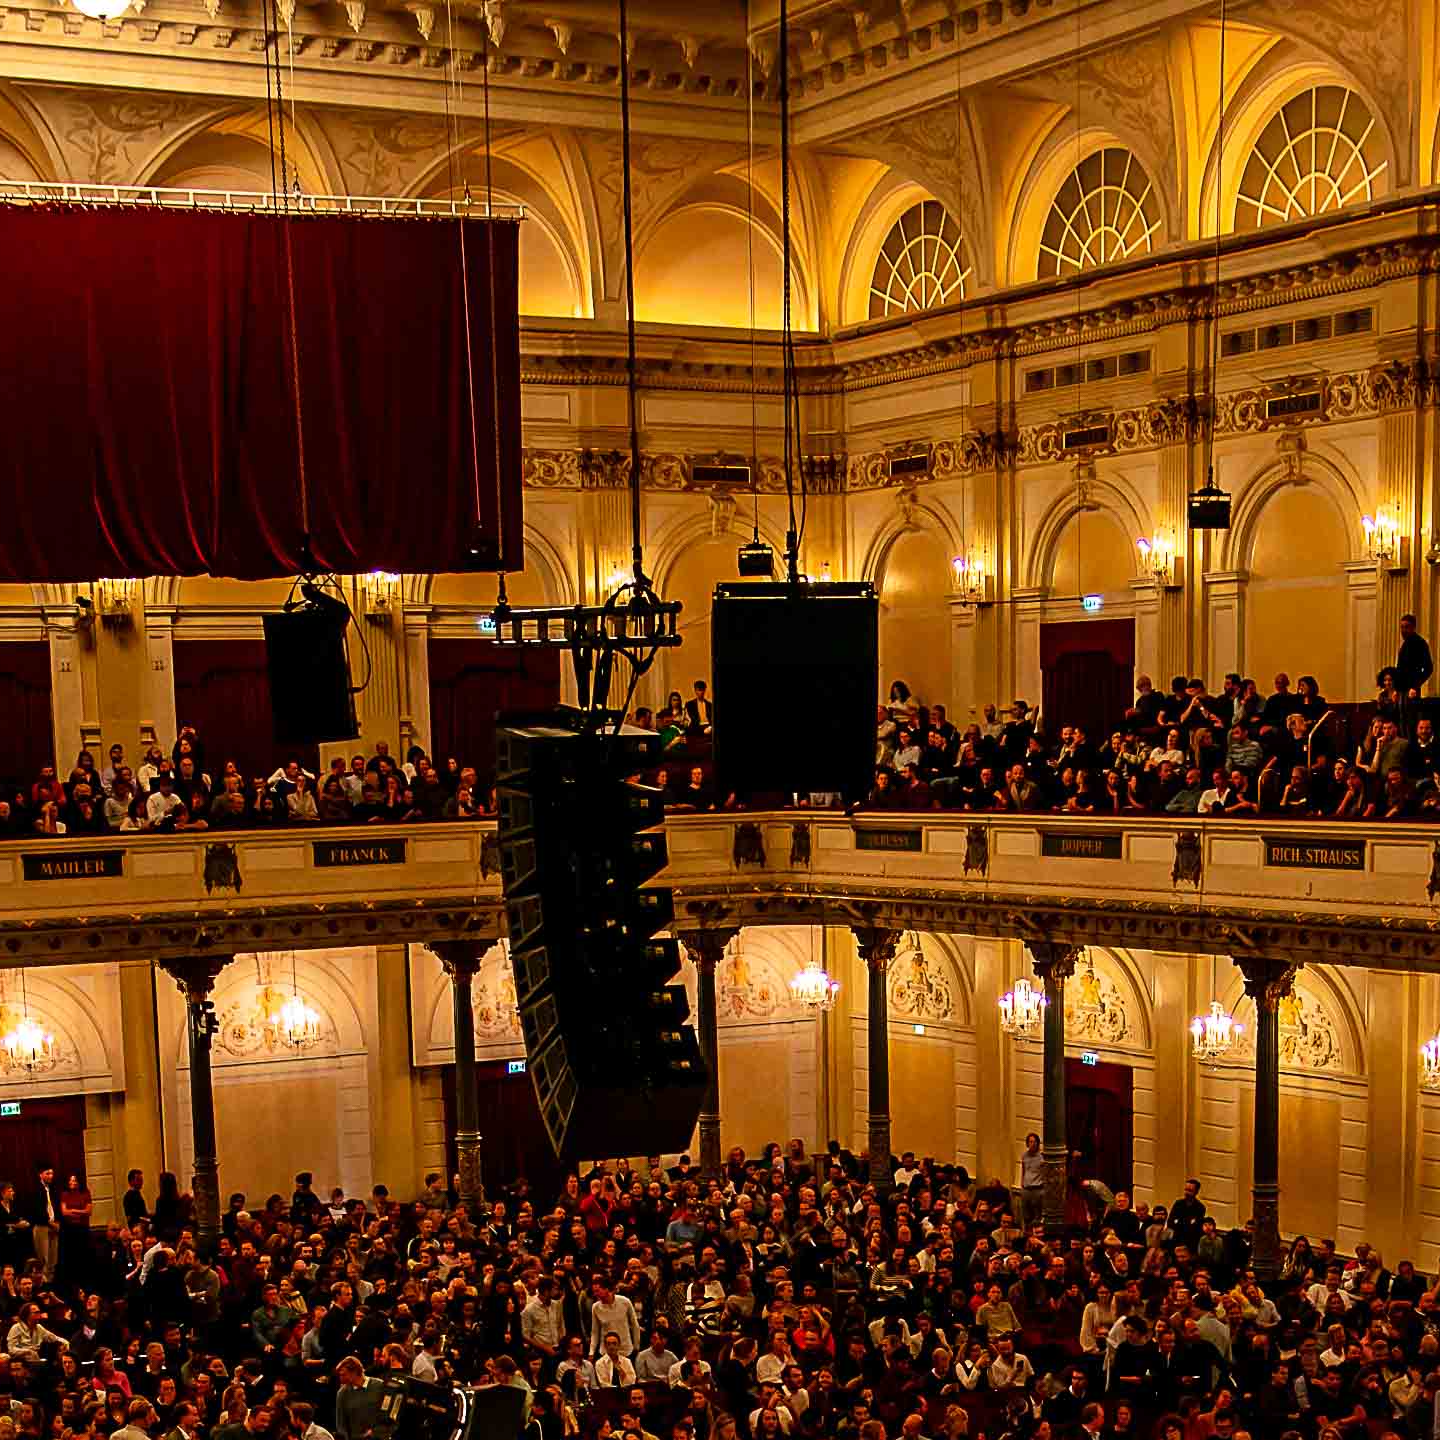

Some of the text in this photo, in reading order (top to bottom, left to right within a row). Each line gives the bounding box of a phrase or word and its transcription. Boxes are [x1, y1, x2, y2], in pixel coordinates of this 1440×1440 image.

[328, 847, 390, 863] FRANCK
[1272, 847, 1360, 865] RICH. STRAUSS
[40, 858, 105, 876] MAHLER
